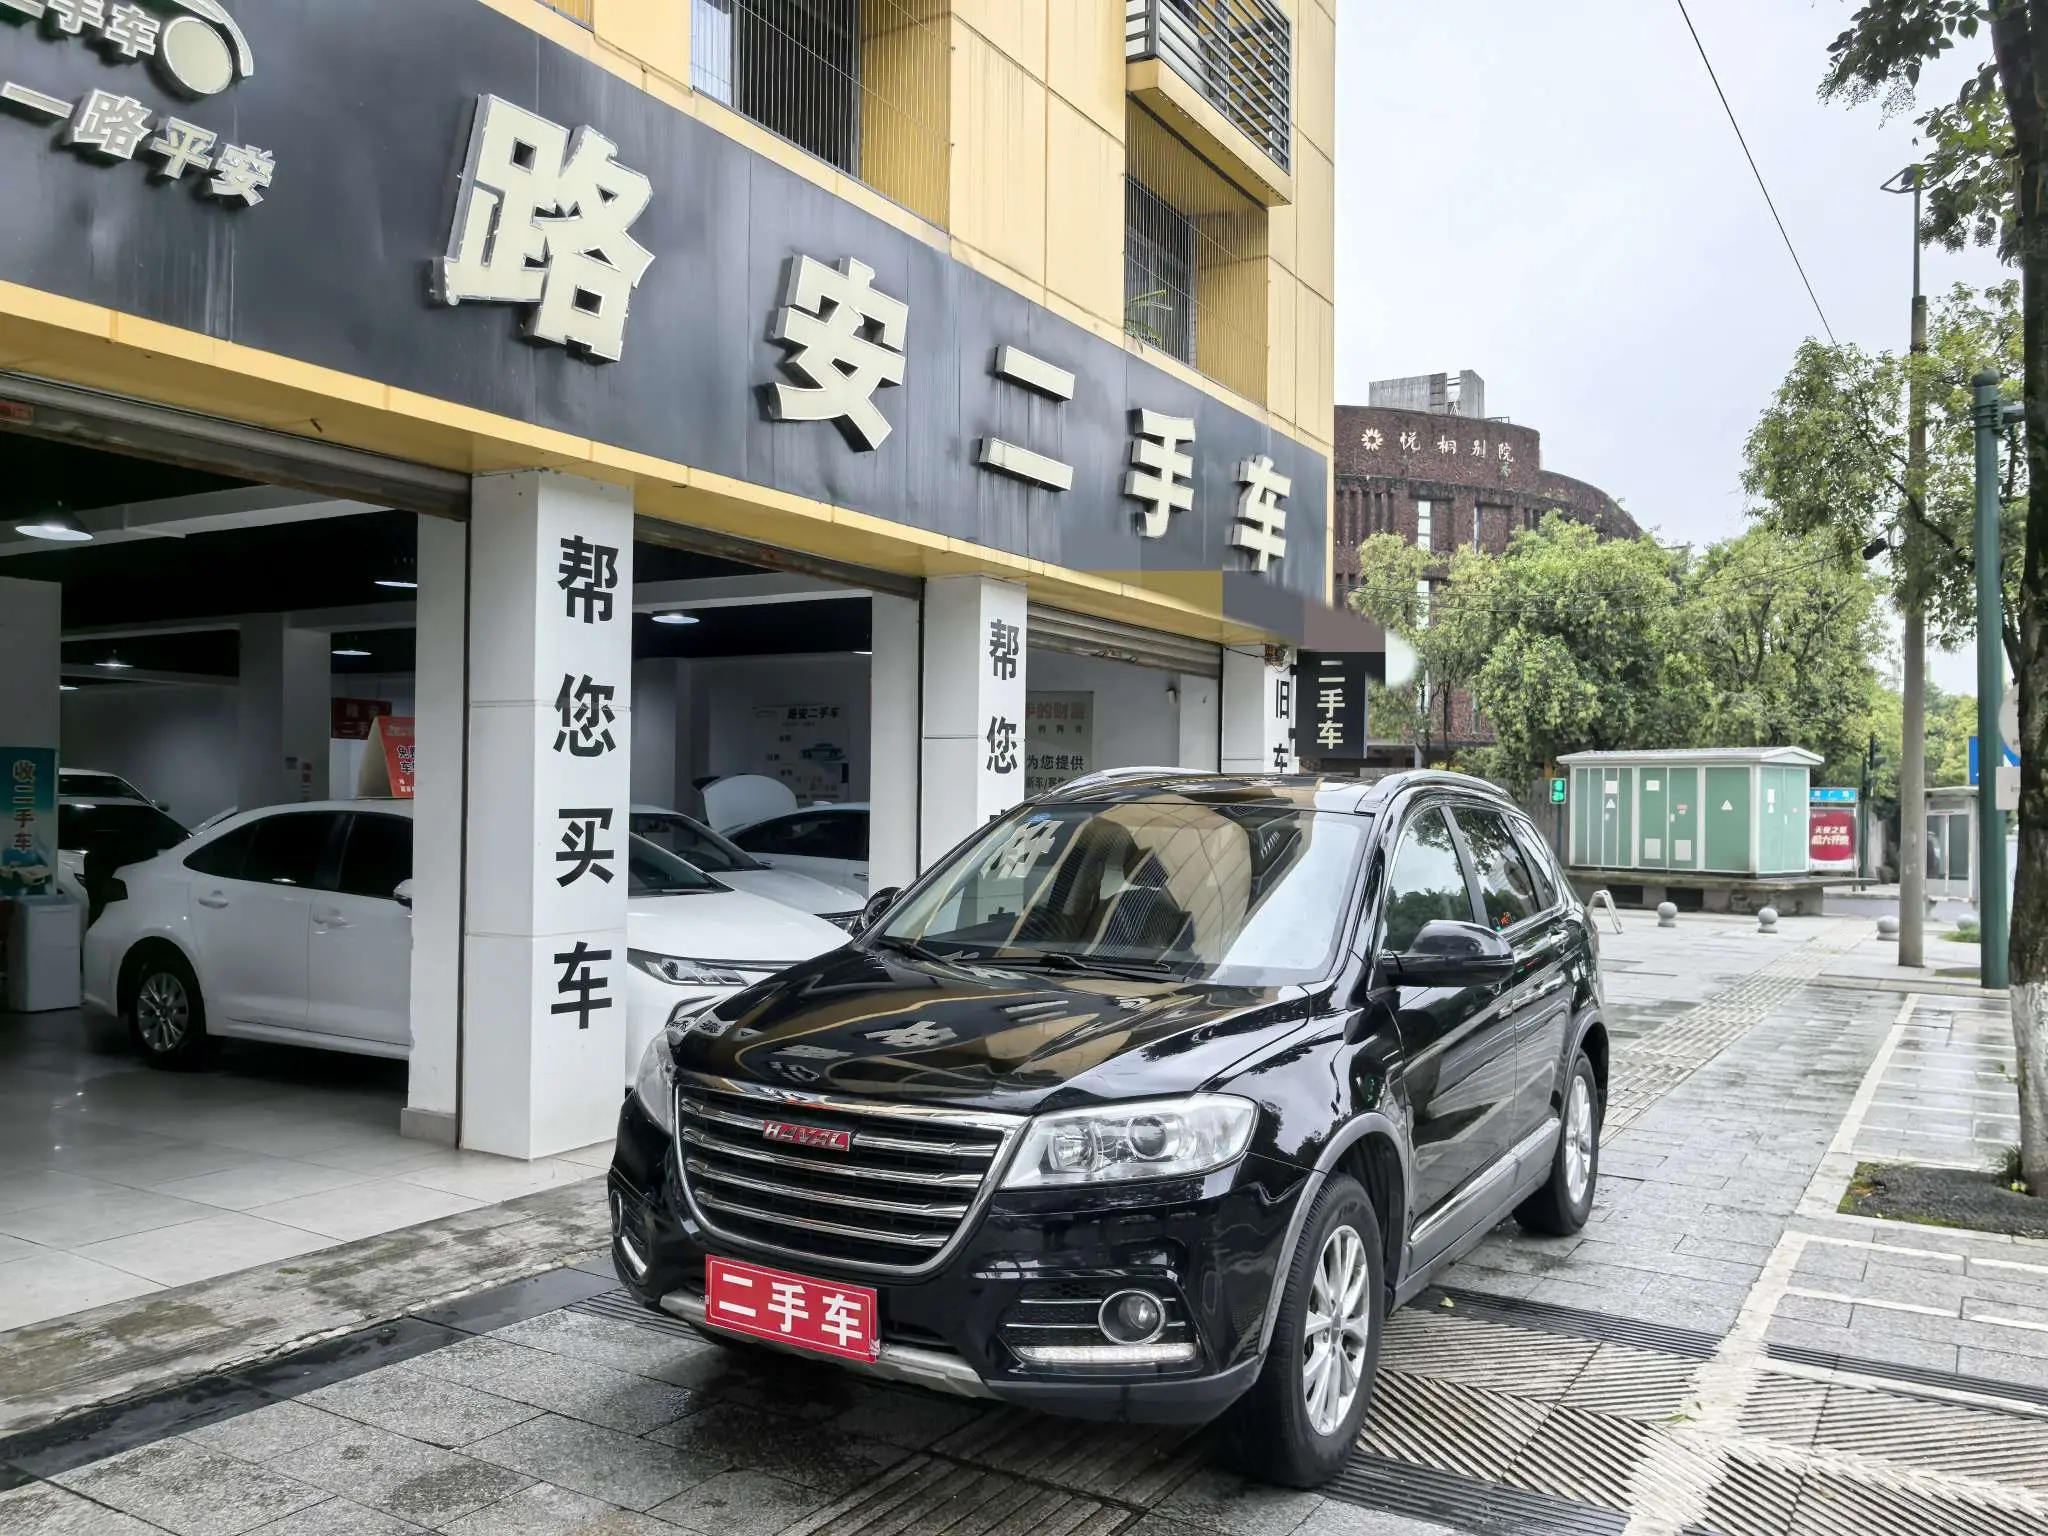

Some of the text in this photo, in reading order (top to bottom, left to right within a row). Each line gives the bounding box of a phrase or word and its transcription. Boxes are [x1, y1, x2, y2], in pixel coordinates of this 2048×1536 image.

[1, 81, 277, 207] 一路平安
[430, 94, 1292, 573] 路安二手车
[1399, 431, 1515, 463] 悦桐别院
[986, 618, 1020, 822] 帮您
[1316, 660, 1346, 750] 二手车
[550, 535, 620, 1030] 帮您买车
[765, 1122, 846, 1149] HAVAL
[718, 1272, 863, 1347] 二手车
